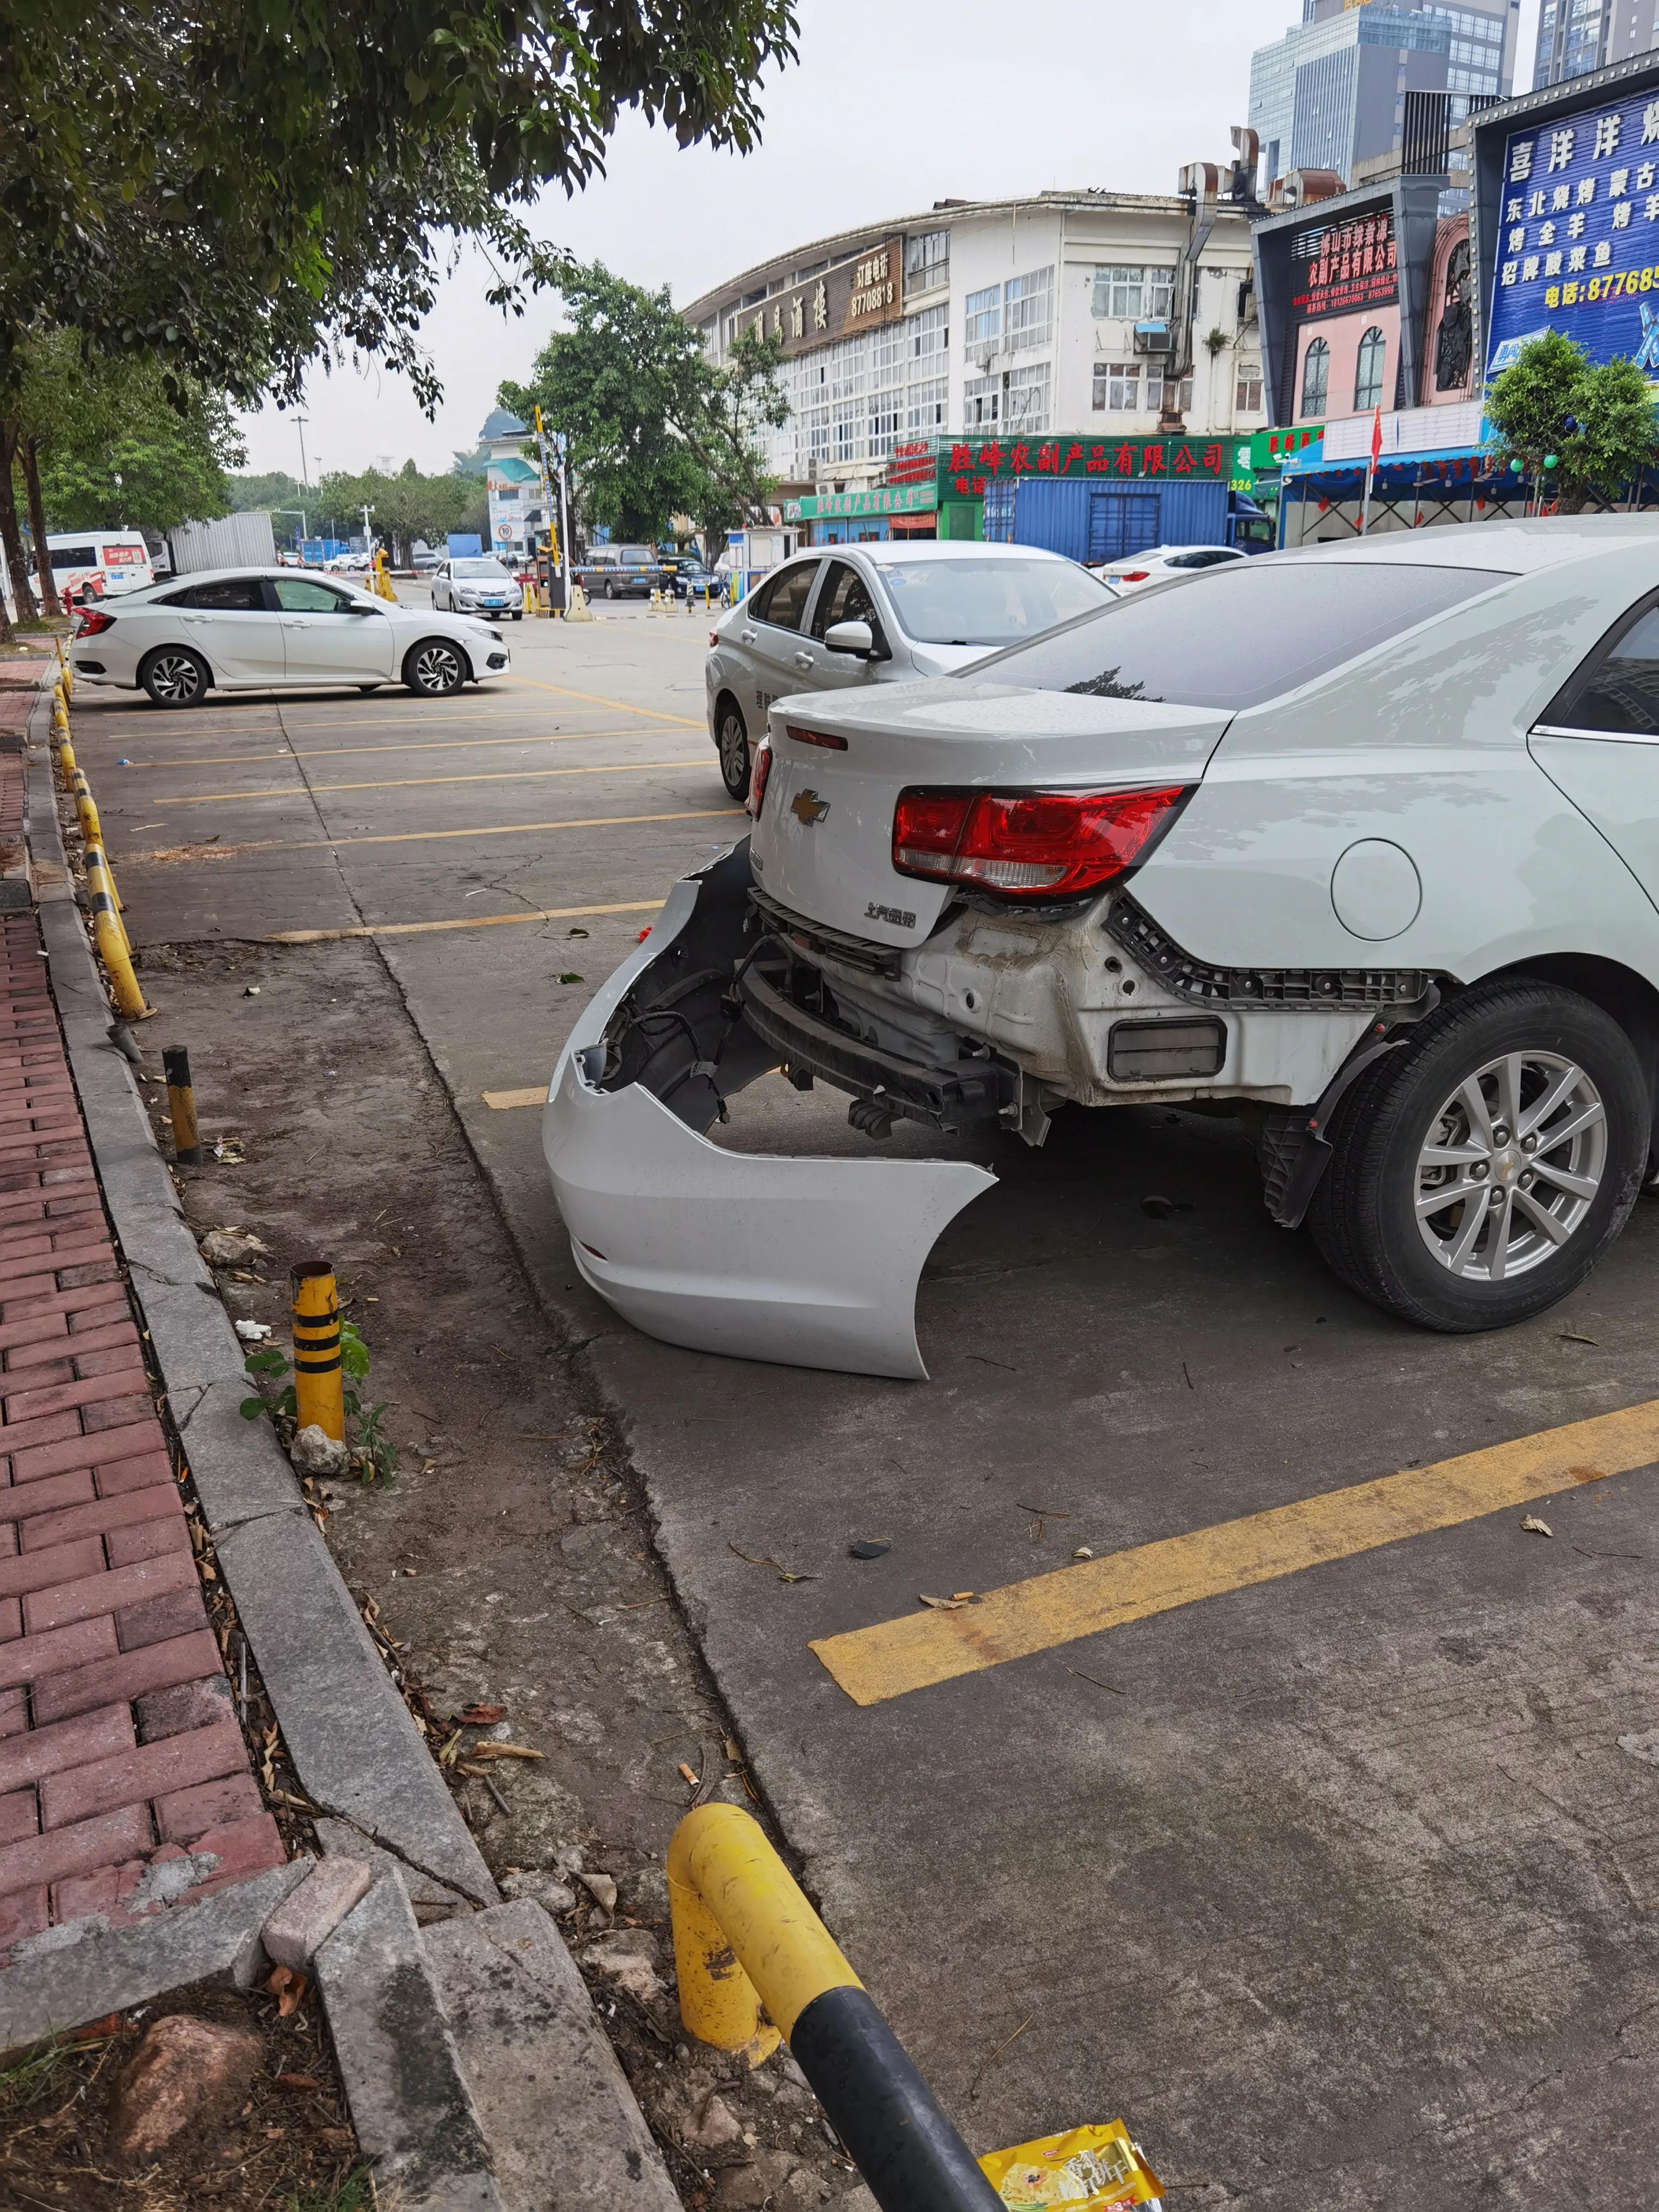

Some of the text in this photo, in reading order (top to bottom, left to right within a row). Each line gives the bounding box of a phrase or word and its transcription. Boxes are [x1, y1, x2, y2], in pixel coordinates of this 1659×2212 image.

[1506, 162, 1656, 222] 东北烧烤 蒙古
[1507, 213, 1585, 254] 烤全羊
[1308, 241, 1397, 288] 农副产品有限公司
[1501, 241, 1611, 286] 招牌酸菜鱼
[852, 282, 893, 318] 87708818
[947, 440, 1223, 476] 胜峰农副产品有限公司
[955, 476, 987, 495] 电话
[1231, 479, 1251, 490] 326
